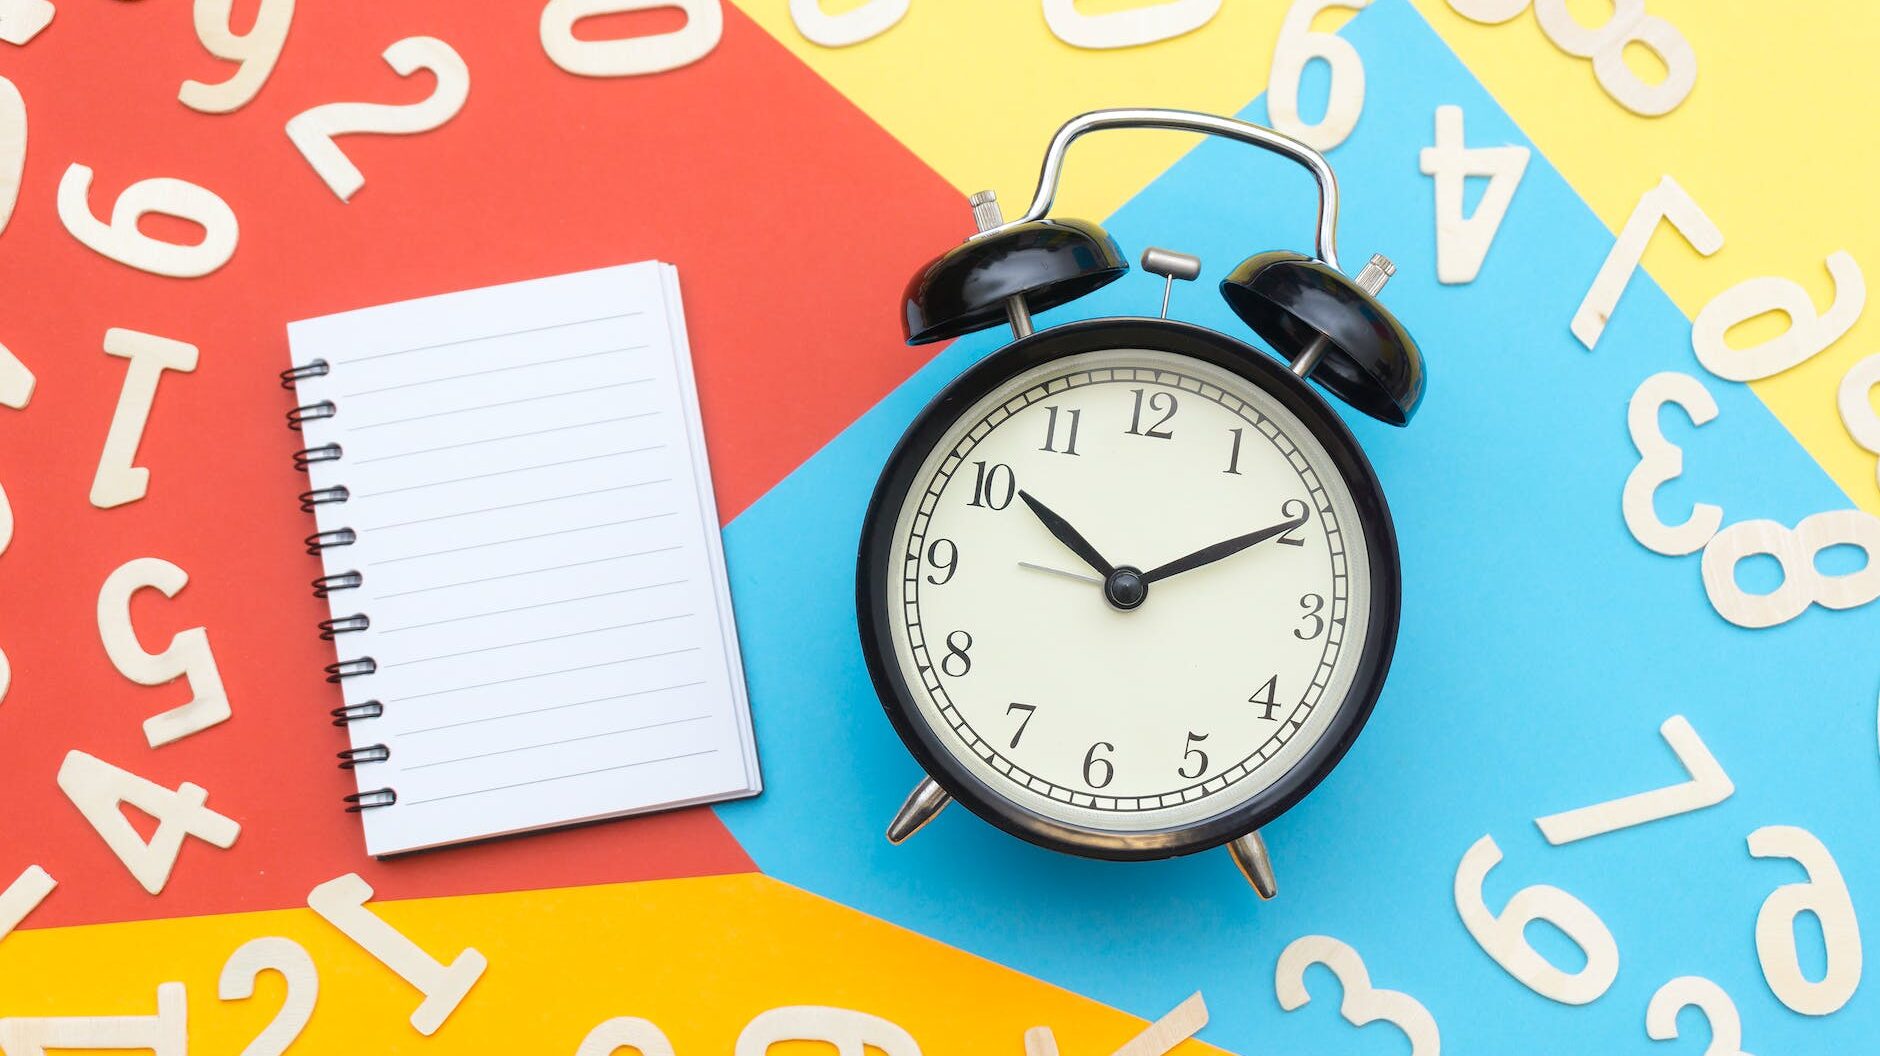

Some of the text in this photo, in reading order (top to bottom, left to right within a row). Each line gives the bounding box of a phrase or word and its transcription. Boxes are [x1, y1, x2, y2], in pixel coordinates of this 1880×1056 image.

[1267, 0, 1368, 153] 6
[285, 36, 470, 204] 2
[1419, 104, 1531, 285] 4
[89, 327, 200, 509] 1
[1038, 405, 1081, 456] 11
[1124, 388, 1178, 440] 12
[1223, 428, 1242, 476] 1
[966, 461, 1016, 511] 10
[1277, 498, 1311, 547] 2
[927, 538, 959, 586] 9
[1701, 509, 1880, 630] 8
[1293, 593, 1325, 641] 3
[97, 557, 232, 749] 5
[941, 630, 973, 678] 8
[1247, 674, 1282, 722] 4
[1005, 702, 1037, 749] 7
[1082, 742, 1115, 789] 6
[1177, 731, 1210, 780] 5
[1533, 714, 1735, 846] 7
[56, 749, 242, 895] 4
[218, 936, 320, 1056] 2
[1275, 934, 1441, 1056] 3
